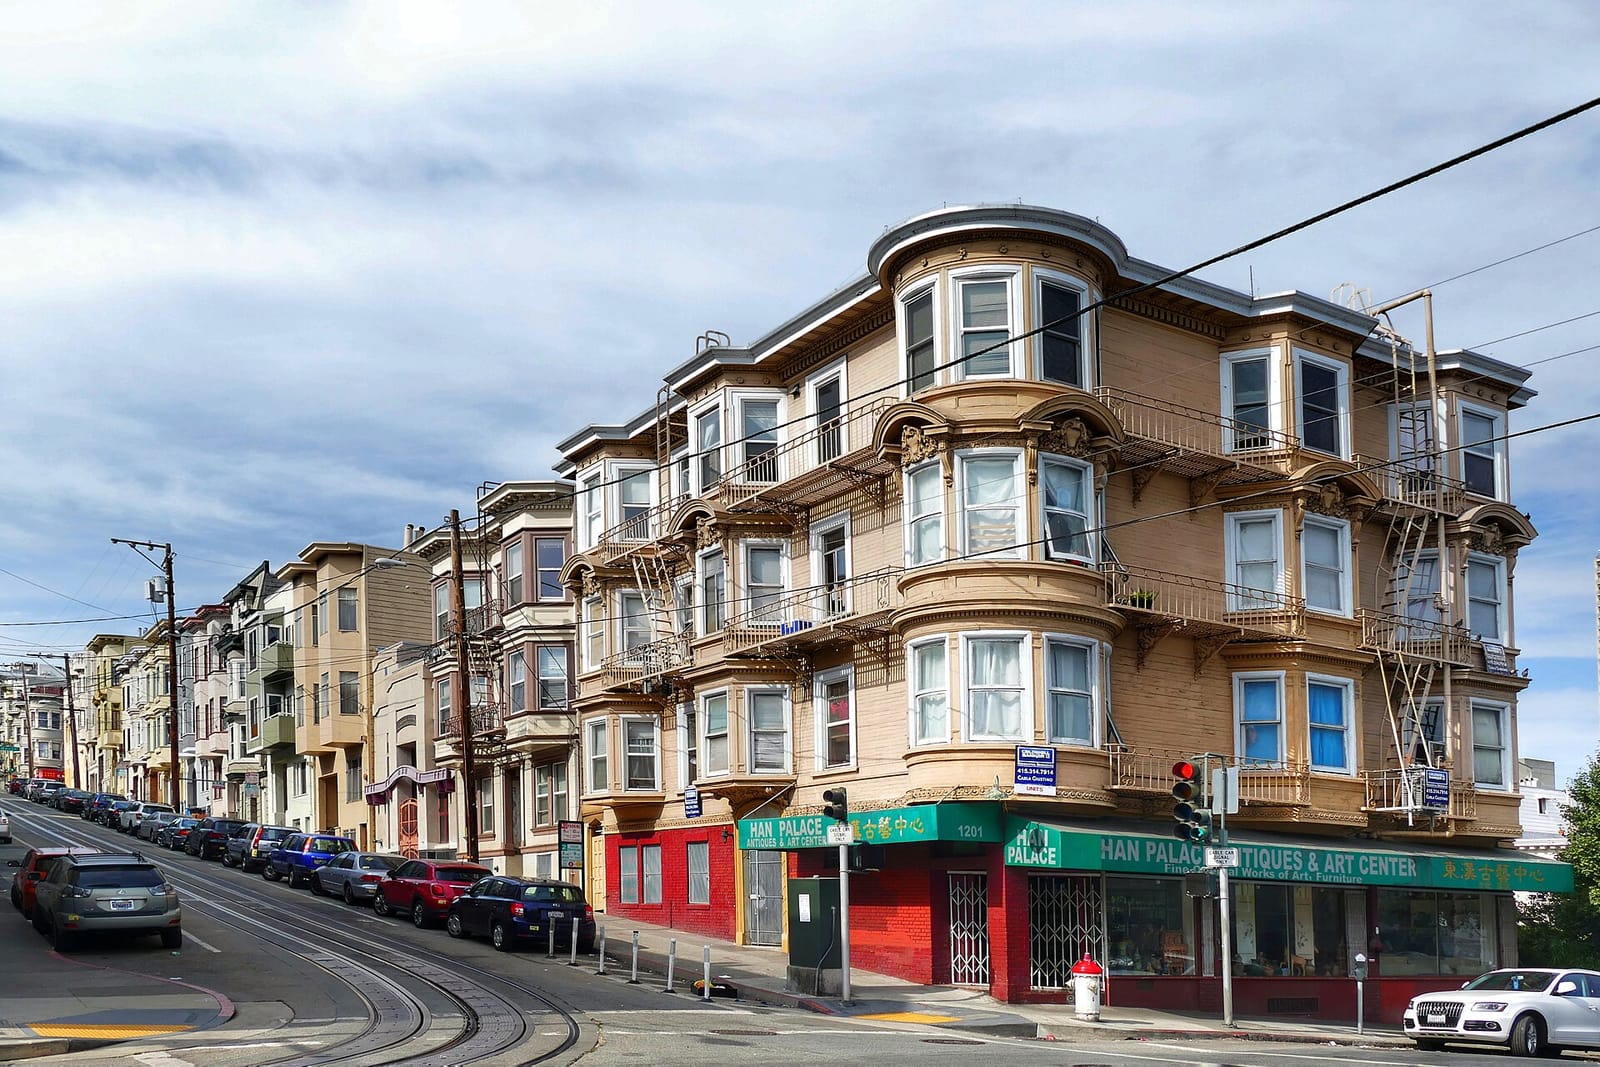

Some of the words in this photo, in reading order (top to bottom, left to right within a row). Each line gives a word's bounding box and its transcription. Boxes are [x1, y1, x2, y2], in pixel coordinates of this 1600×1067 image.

[750, 821, 772, 837] HAN
[779, 818, 822, 837] PALACE
[958, 825, 983, 838] 1201
[746, 838, 776, 847] ANTIQUES
[779, 838, 784, 847] &
[787, 836, 800, 847] ART
[801, 835, 827, 846] CENTER
[1017, 828, 1048, 846] HAN
[1008, 846, 1056, 864] PALACE
[1101, 838, 1140, 862] HAN
[1146, 840, 1205, 867] PALAC
[1239, 847, 1303, 871] TIQUES
[1308, 851, 1319, 873] &
[1324, 853, 1354, 874] ART
[1359, 855, 1417, 877] CENTER
[1164, 863, 1190, 874] Fine
[1242, 868, 1275, 879] Works
[1278, 869, 1289, 880] of
[1316, 872, 1363, 884] Furniture
